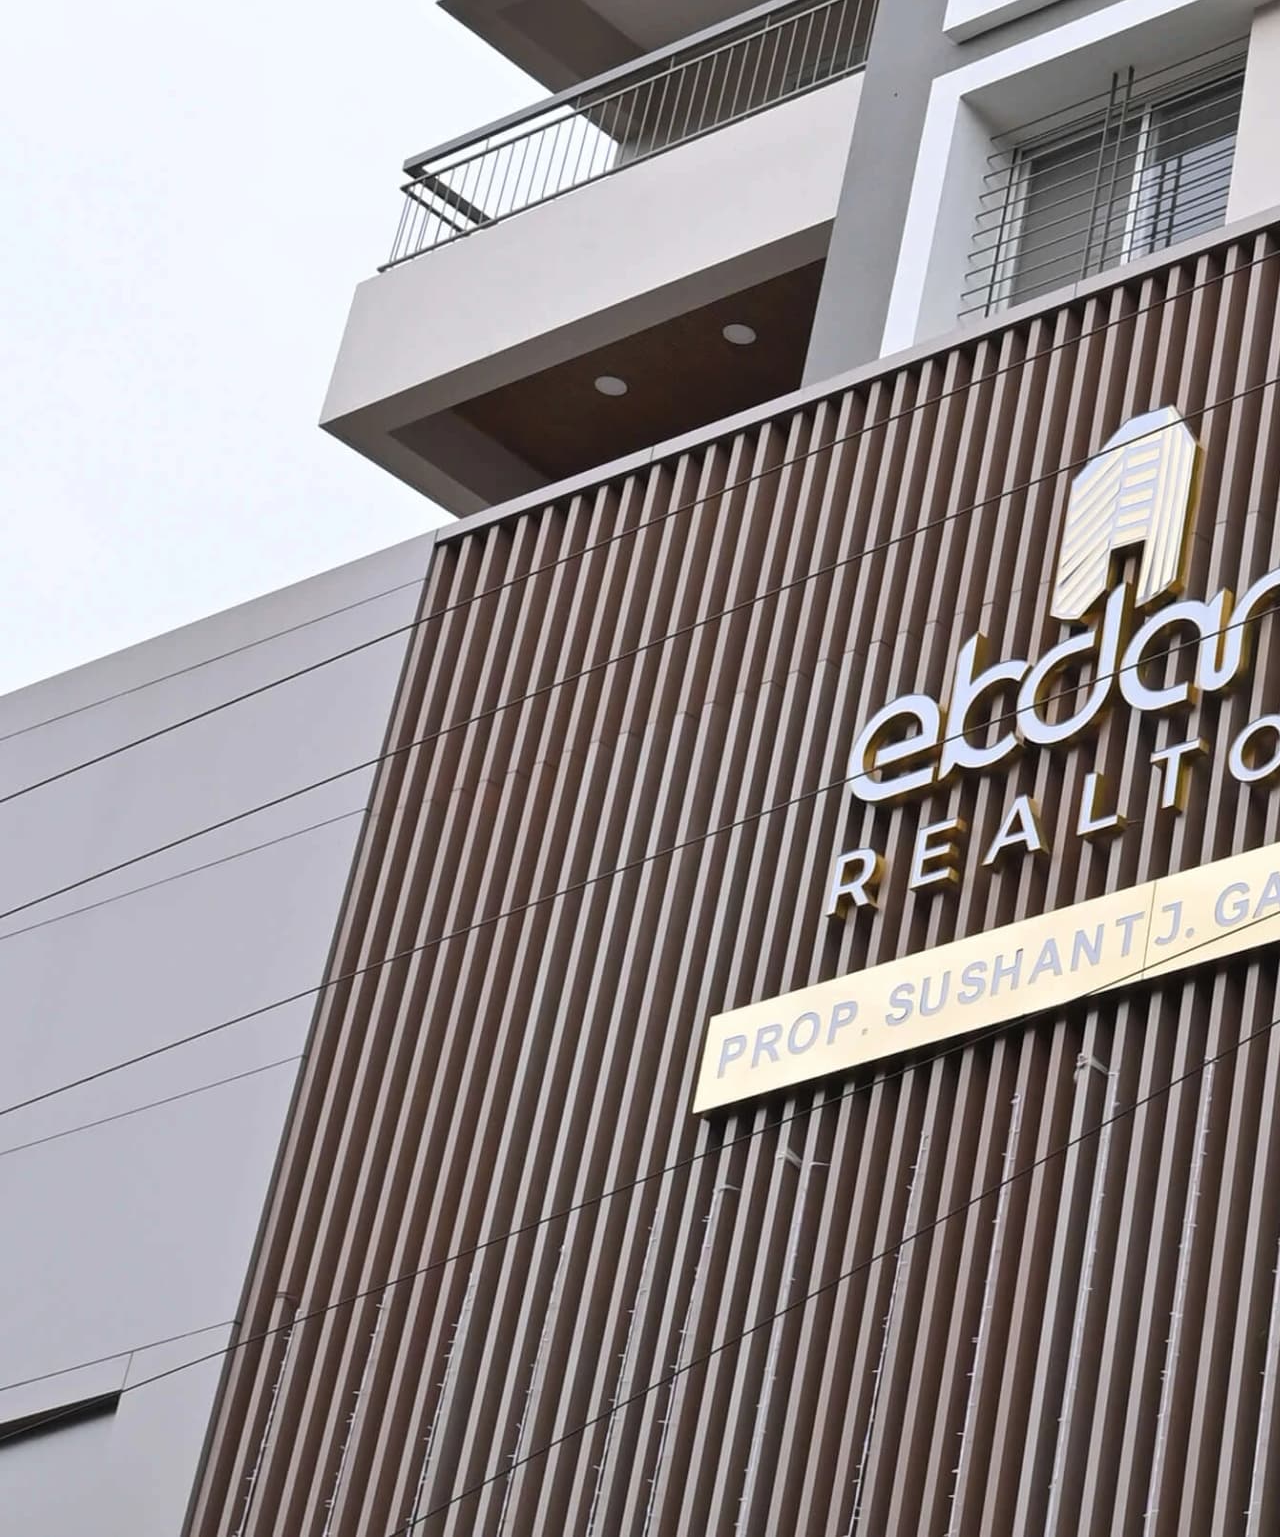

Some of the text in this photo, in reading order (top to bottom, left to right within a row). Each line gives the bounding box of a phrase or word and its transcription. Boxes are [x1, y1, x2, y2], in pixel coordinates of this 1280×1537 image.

[716, 1000, 868, 1080] PROP.
[885, 910, 1145, 1028] SUSHANT
[1154, 900, 1197, 947] J.
